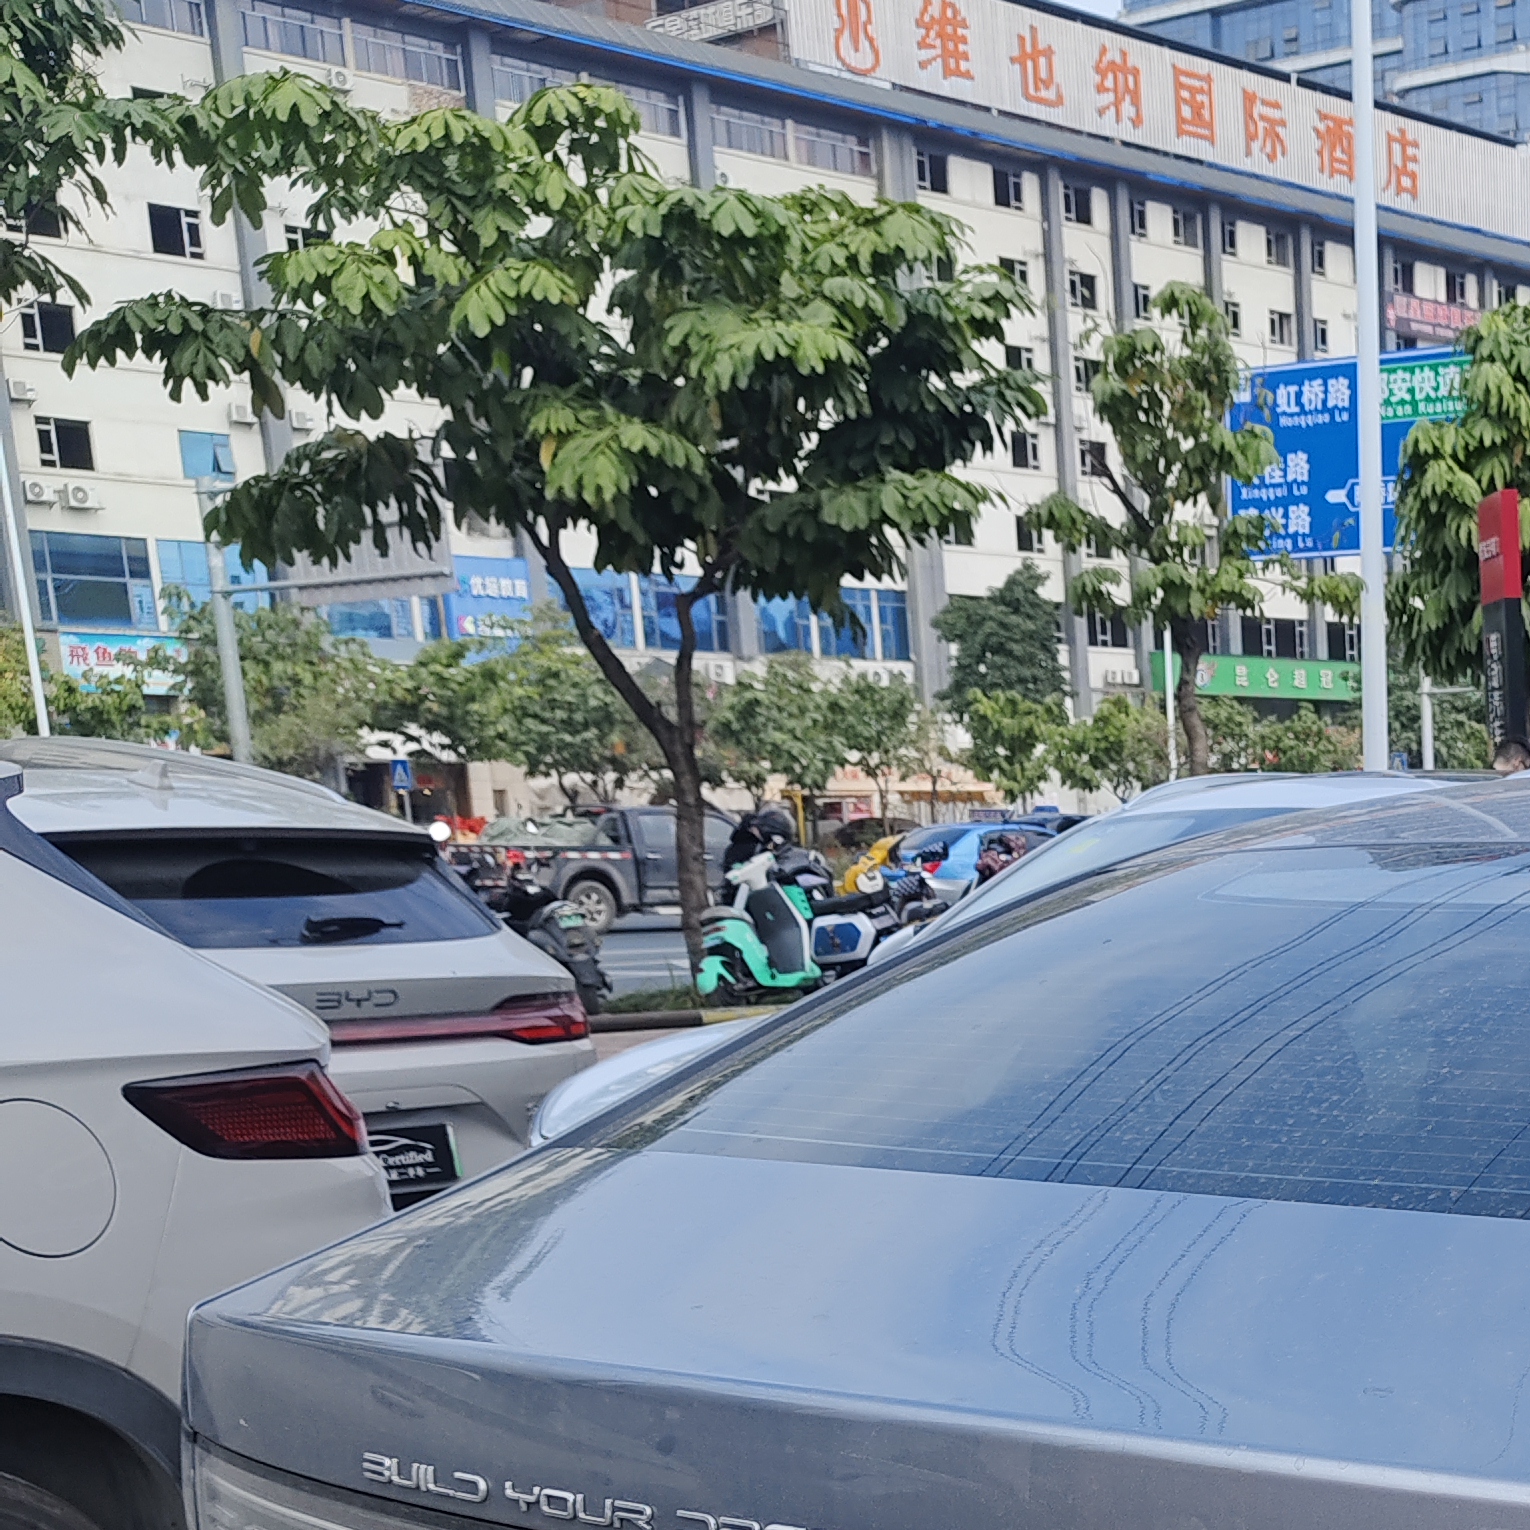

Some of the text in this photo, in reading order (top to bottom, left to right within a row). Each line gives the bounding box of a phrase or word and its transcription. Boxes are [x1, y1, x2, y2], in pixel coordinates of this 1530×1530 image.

[916, 0, 1420, 201] 维也纳国际酒店
[1275, 376, 1351, 414] 虹桥路
[1333, 409, 1349, 423] Lu
[1292, 482, 1309, 496] Lu
[315, 988, 399, 1011] BYD
[362, 1451, 488, 1503] BUILD
